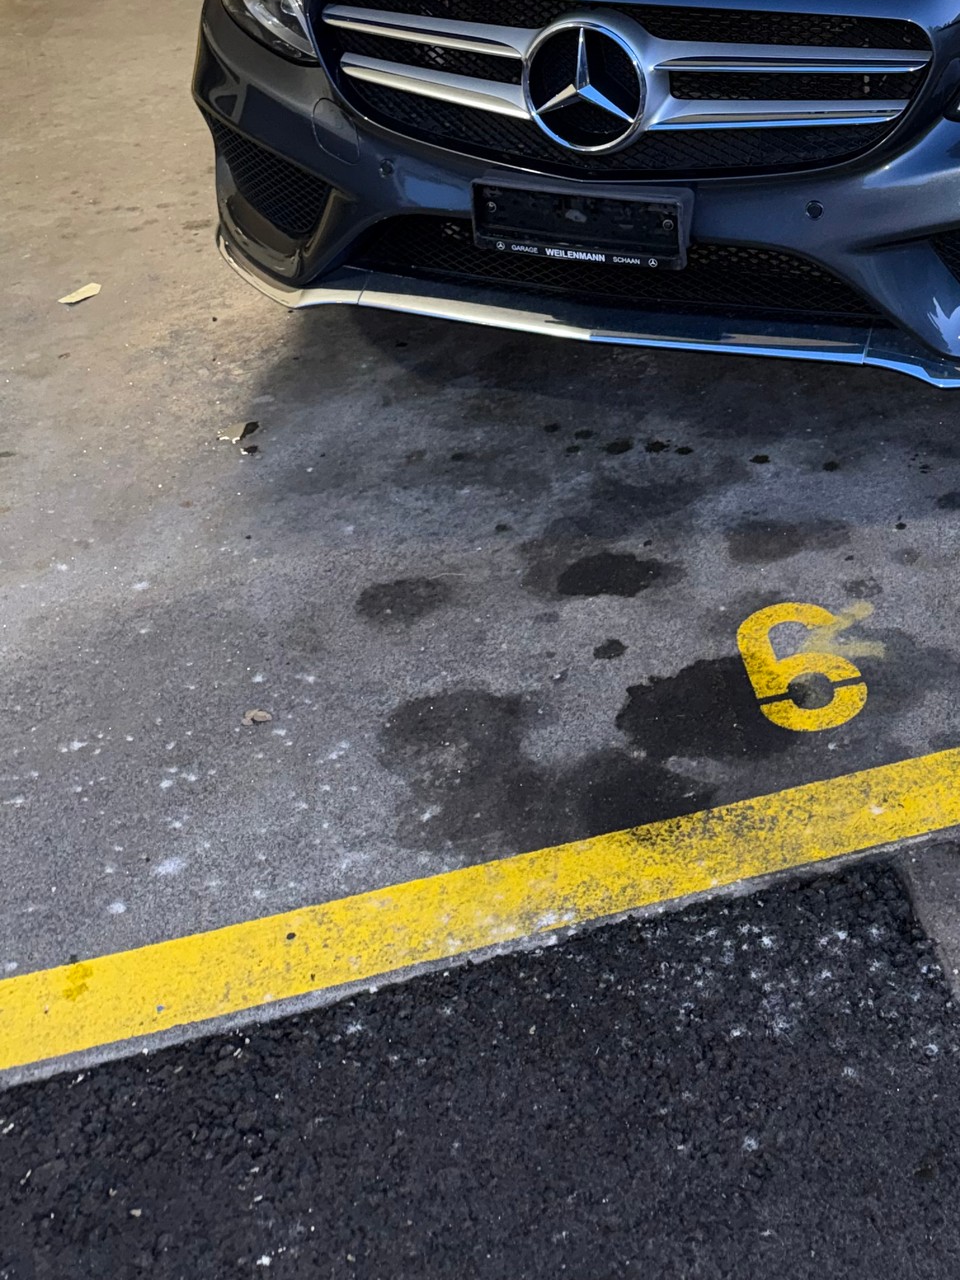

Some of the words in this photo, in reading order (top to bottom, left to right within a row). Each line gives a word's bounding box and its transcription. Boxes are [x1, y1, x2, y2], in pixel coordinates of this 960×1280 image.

[511, 244, 539, 254] GARAGE
[545, 248, 606, 262] WEILENMANN
[612, 256, 641, 265] SCHAAN
[736, 602, 868, 732] 6
